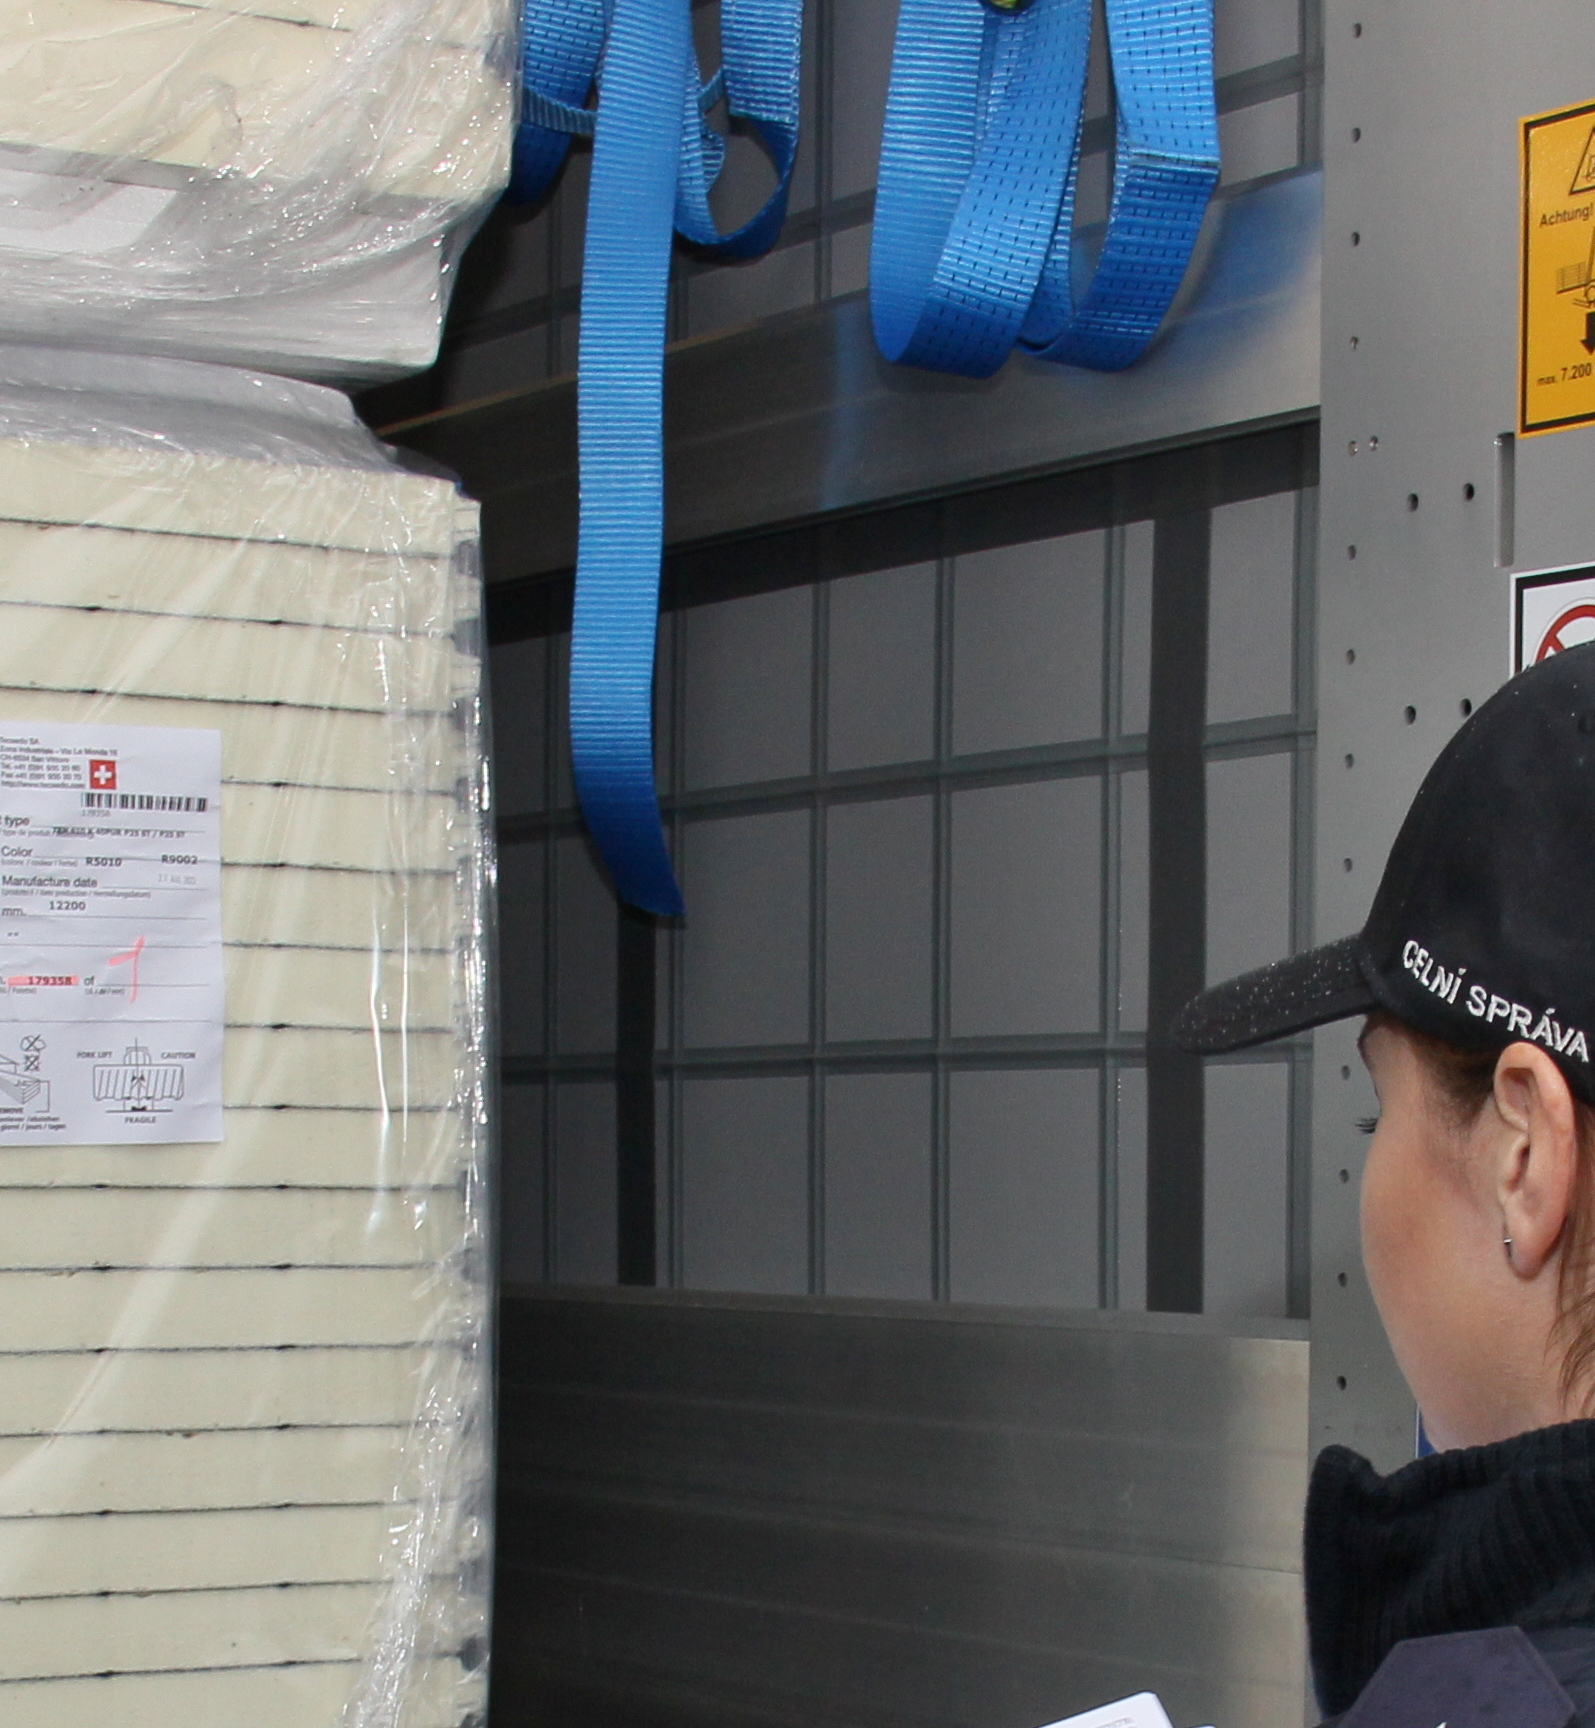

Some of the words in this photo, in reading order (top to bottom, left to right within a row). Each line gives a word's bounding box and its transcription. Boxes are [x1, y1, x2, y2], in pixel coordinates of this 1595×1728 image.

[1539, 204, 1593, 228] Achtung!
[1560, 362, 1592, 382] 7.200
[5, 815, 29, 827] type
[1, 845, 33, 857] Color
[85, 857, 122, 867] R5010
[1, 876, 70, 888] Manufacture
[73, 878, 97, 888] date
[1, 907, 26, 916] mm.
[49, 901, 86, 911] 12200
[28, 976, 72, 985] 179358
[83, 976, 95, 985] of
[1403, 939, 1466, 1005] CELNÍ
[1466, 984, 1590, 1063] SPRÁVA
[124, 1116, 156, 1124] FRAGILE
